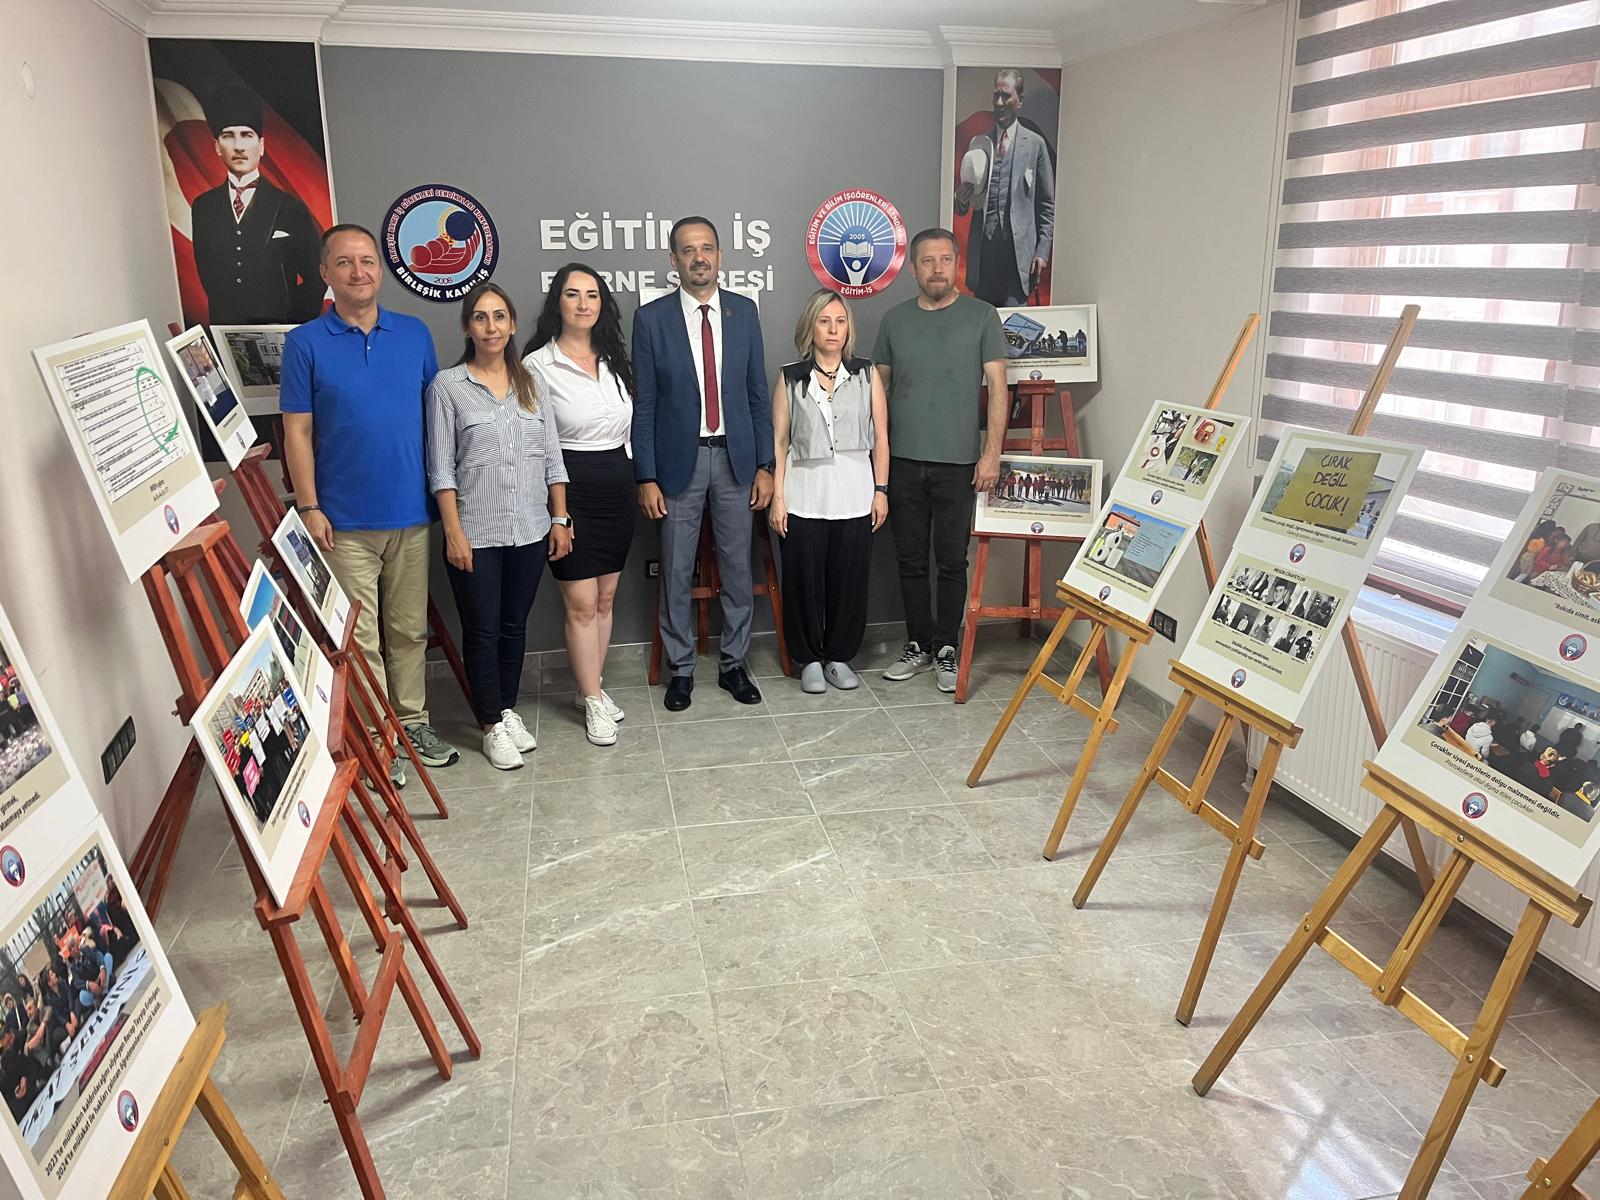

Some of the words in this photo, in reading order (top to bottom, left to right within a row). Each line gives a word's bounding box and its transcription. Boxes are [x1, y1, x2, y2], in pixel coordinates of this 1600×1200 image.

[733, 213, 771, 257] İŞ
[817, 208, 827, 218] VE
[396, 266, 442, 298] BİRLEŞİK
[1305, 491, 1350, 517] ÇOCUK!
[1430, 741, 1453, 757] Çocuklar
[1452, 753, 1467, 766] siyasi
[1466, 760, 1491, 779] partilerin
[1491, 775, 1507, 790] dolgu
[1507, 784, 1537, 806] malzemesi
[1536, 801, 1560, 820] değildir.
[45, 1149, 63, 1176] 2023'te
[124, 1024, 137, 1045] Recep
[134, 1007, 148, 1026] Tayyip
[56, 1154, 75, 1180] 2024'te
[73, 1123, 91, 1154] mülakat
[94, 1090, 109, 1115] hakları
[119, 1032, 144, 1072] öğretmenlere
